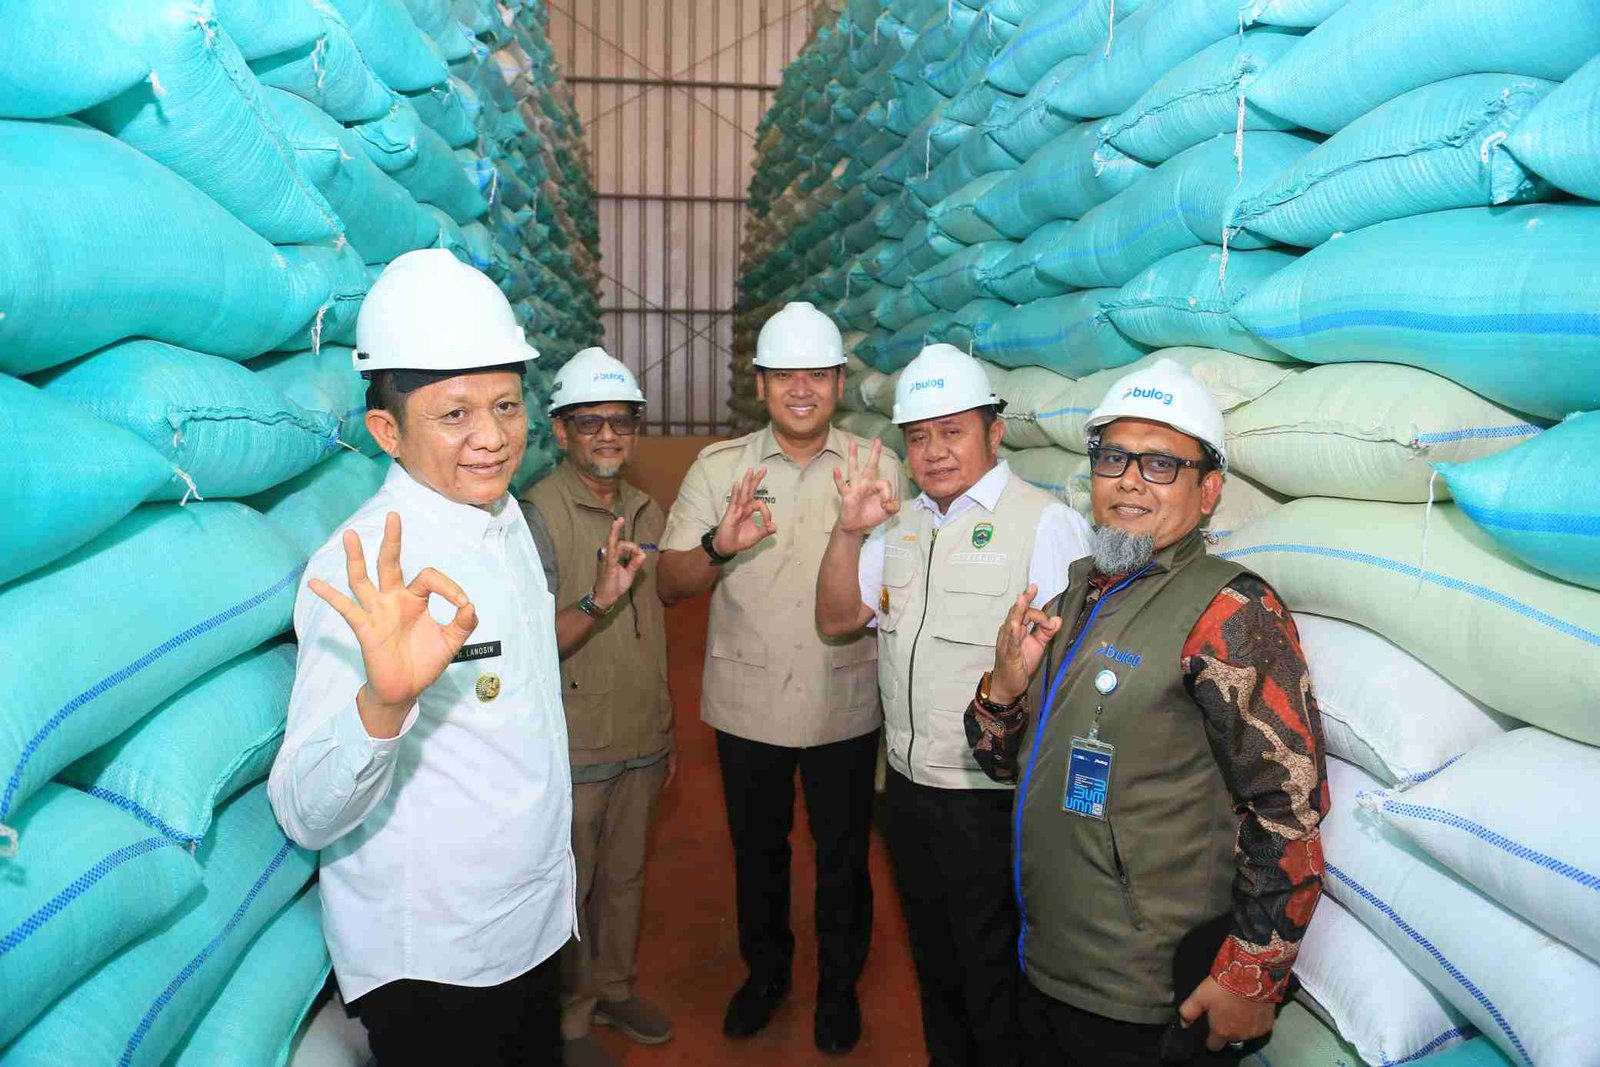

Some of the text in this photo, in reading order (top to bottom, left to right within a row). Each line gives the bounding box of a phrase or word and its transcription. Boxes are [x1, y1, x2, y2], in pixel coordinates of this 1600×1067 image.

[600, 372, 625, 383] bulog
[915, 378, 945, 391] bulog
[1132, 386, 1174, 406] bulog
[466, 645, 494, 657] LANOSIN
